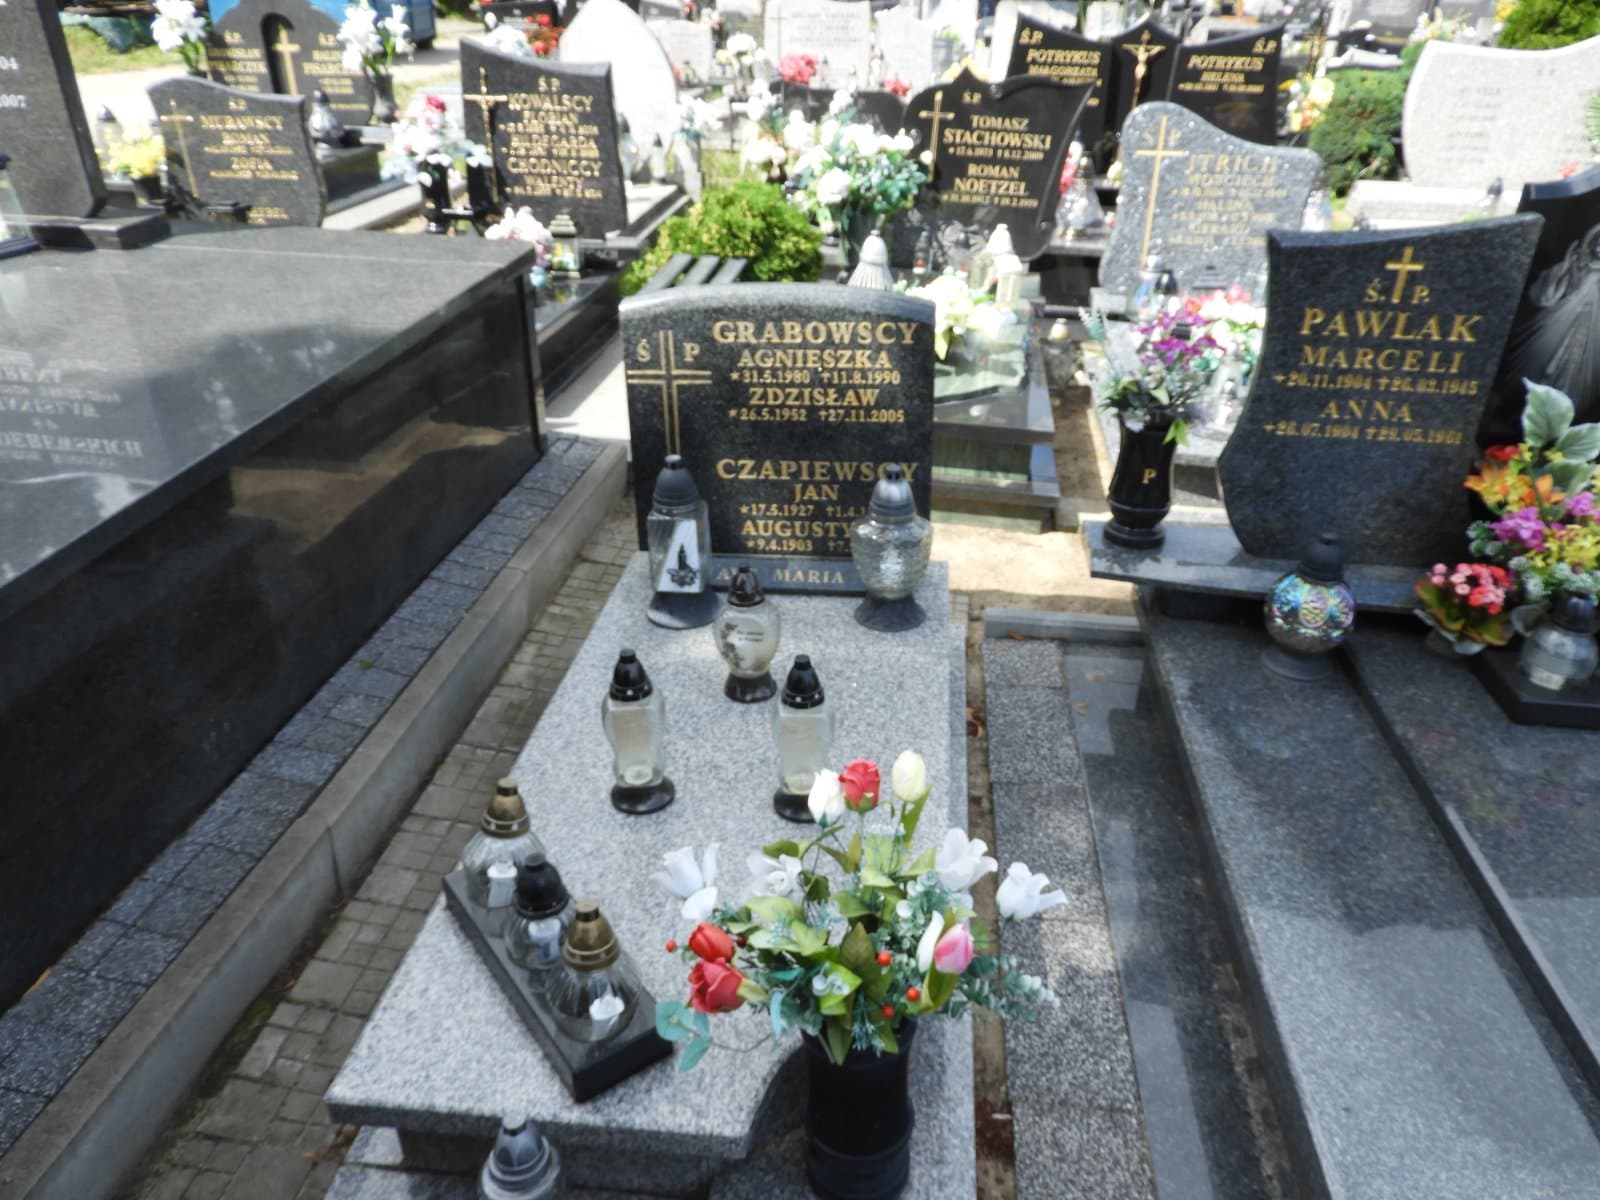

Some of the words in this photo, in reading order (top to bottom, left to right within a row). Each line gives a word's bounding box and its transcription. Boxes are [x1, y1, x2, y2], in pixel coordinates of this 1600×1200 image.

[1026, 49, 1101, 65] POTRYKUS
[1187, 55, 1265, 71] POTRYKUS
[507, 93, 594, 112] KOWALSCY
[970, 114, 1029, 131] TOMASZ
[943, 128, 1052, 150] STACHOWSKI
[968, 163, 1020, 179] ROMAN
[712, 320, 921, 345] GRABOWSCY
[1300, 307, 1483, 342] PAWLAK
[683, 342, 700, 363] P
[738, 349, 893, 369] AGNIESZKA
[1300, 345, 1464, 374] MARCELI
[749, 387, 880, 406] ZDZISŁAW
[1320, 400, 1413, 423] ANNA
[716, 458, 920, 483] CZAPIEWSCY
[1142, 468, 1157, 485] P
[794, 484, 840, 503] JAN
[774, 569, 844, 584] MARIA
